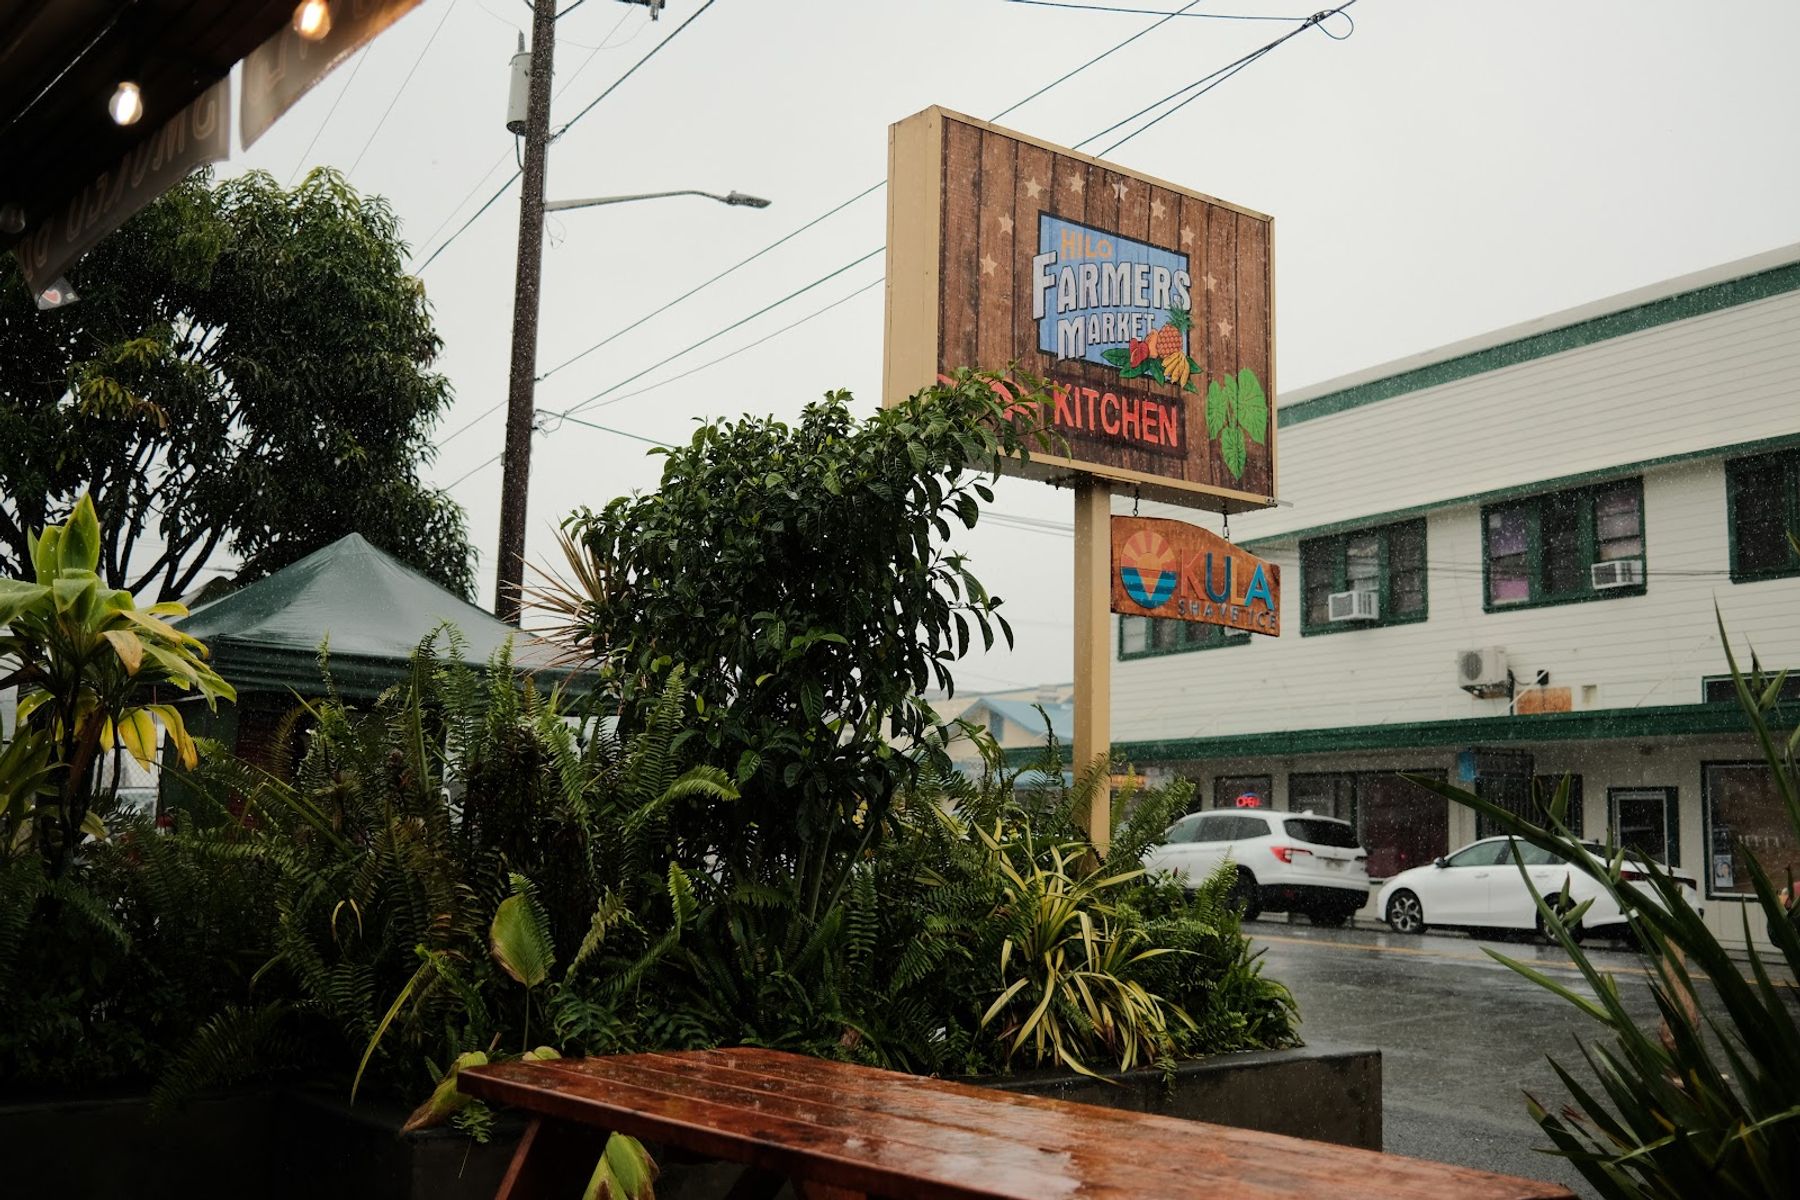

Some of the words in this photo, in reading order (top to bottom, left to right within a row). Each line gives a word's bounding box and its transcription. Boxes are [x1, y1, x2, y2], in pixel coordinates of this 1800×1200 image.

[1060, 228, 1114, 259] HILO
[1032, 251, 1192, 320] FARMERS
[1057, 311, 1155, 361] MARKET
[1052, 380, 1178, 447] KITCHEN
[1180, 548, 1275, 611] KULA
[1178, 599, 1239, 624] SHAVE
[1249, 608, 1277, 630] ICE
